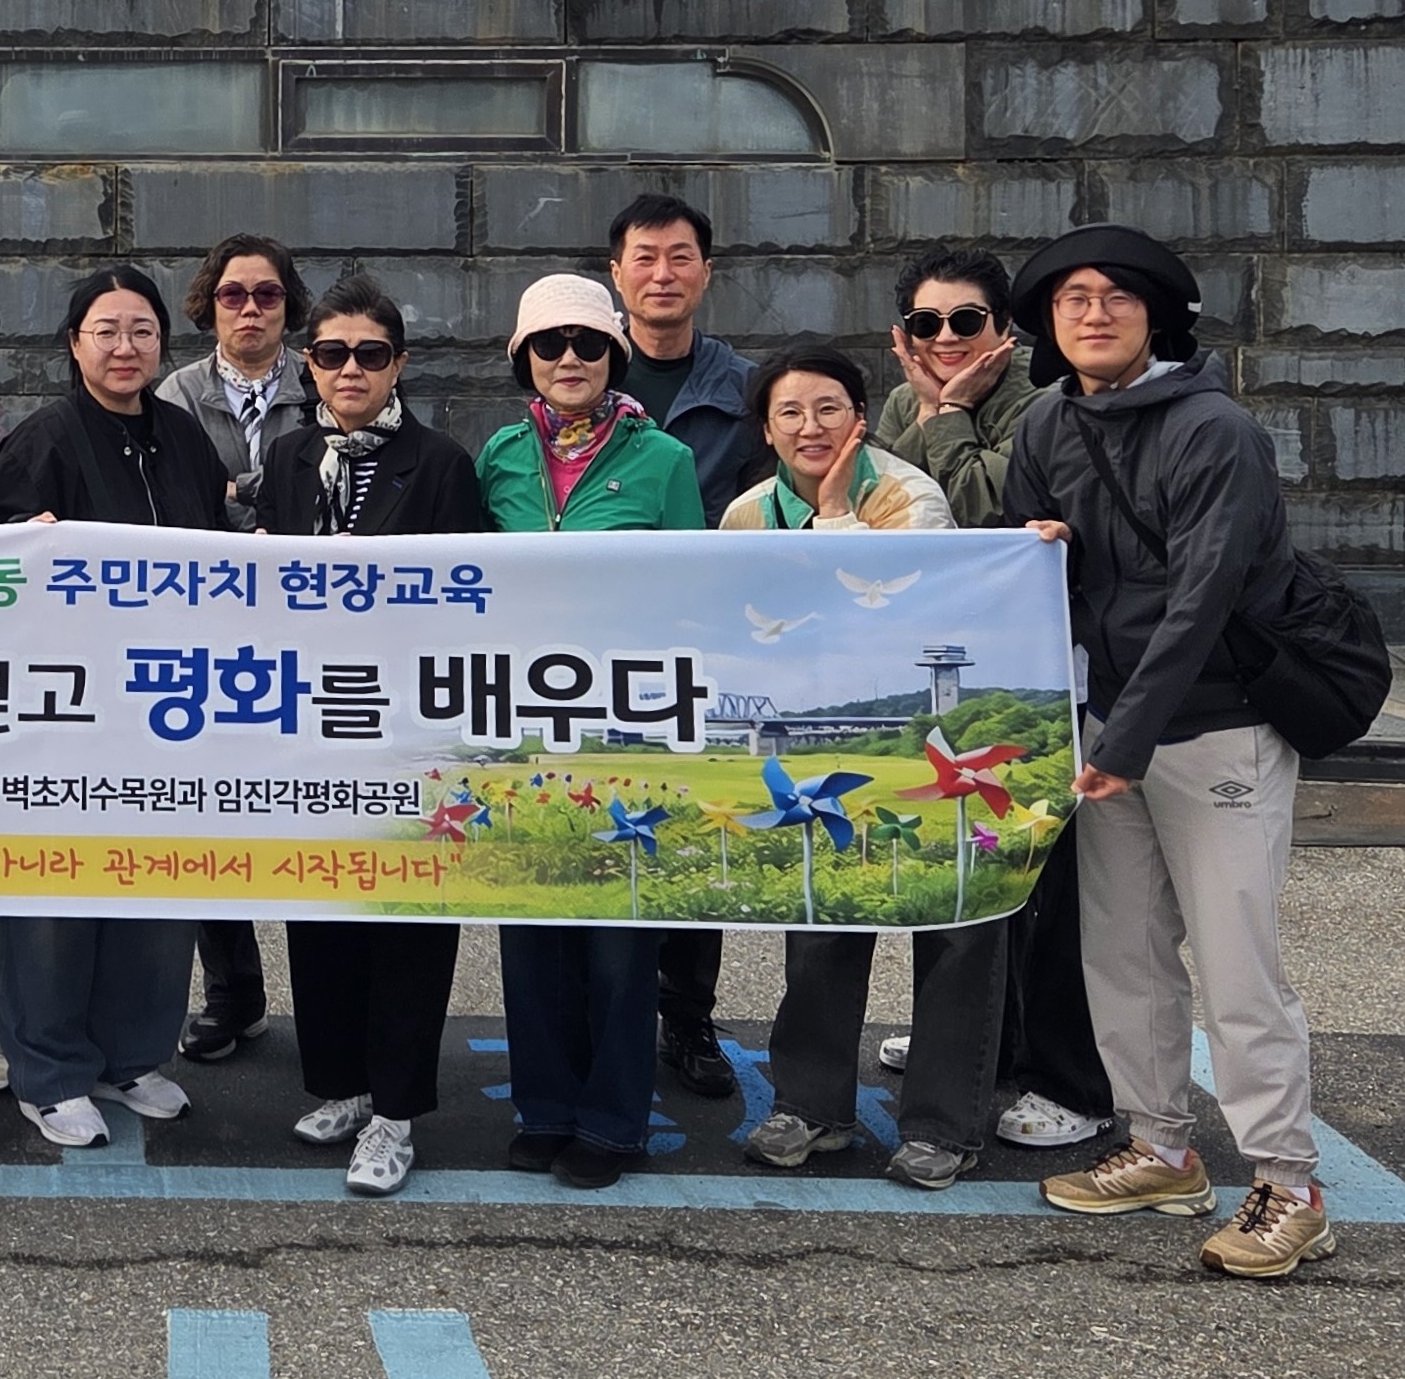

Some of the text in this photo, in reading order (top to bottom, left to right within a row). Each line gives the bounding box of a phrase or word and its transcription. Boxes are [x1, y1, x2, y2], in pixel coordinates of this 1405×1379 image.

[46, 559, 258, 608] 주민자치
[279, 561, 493, 614] 현장교육
[125, 645, 391, 742] 평화를
[419, 654, 708, 744] 배우다
[2, 774, 208, 813] 벽초지수목원과
[214, 779, 422, 815] 임진각평화공원
[1213, 799, 1252, 809] umbro
[103, 847, 253, 886] 관계에서
